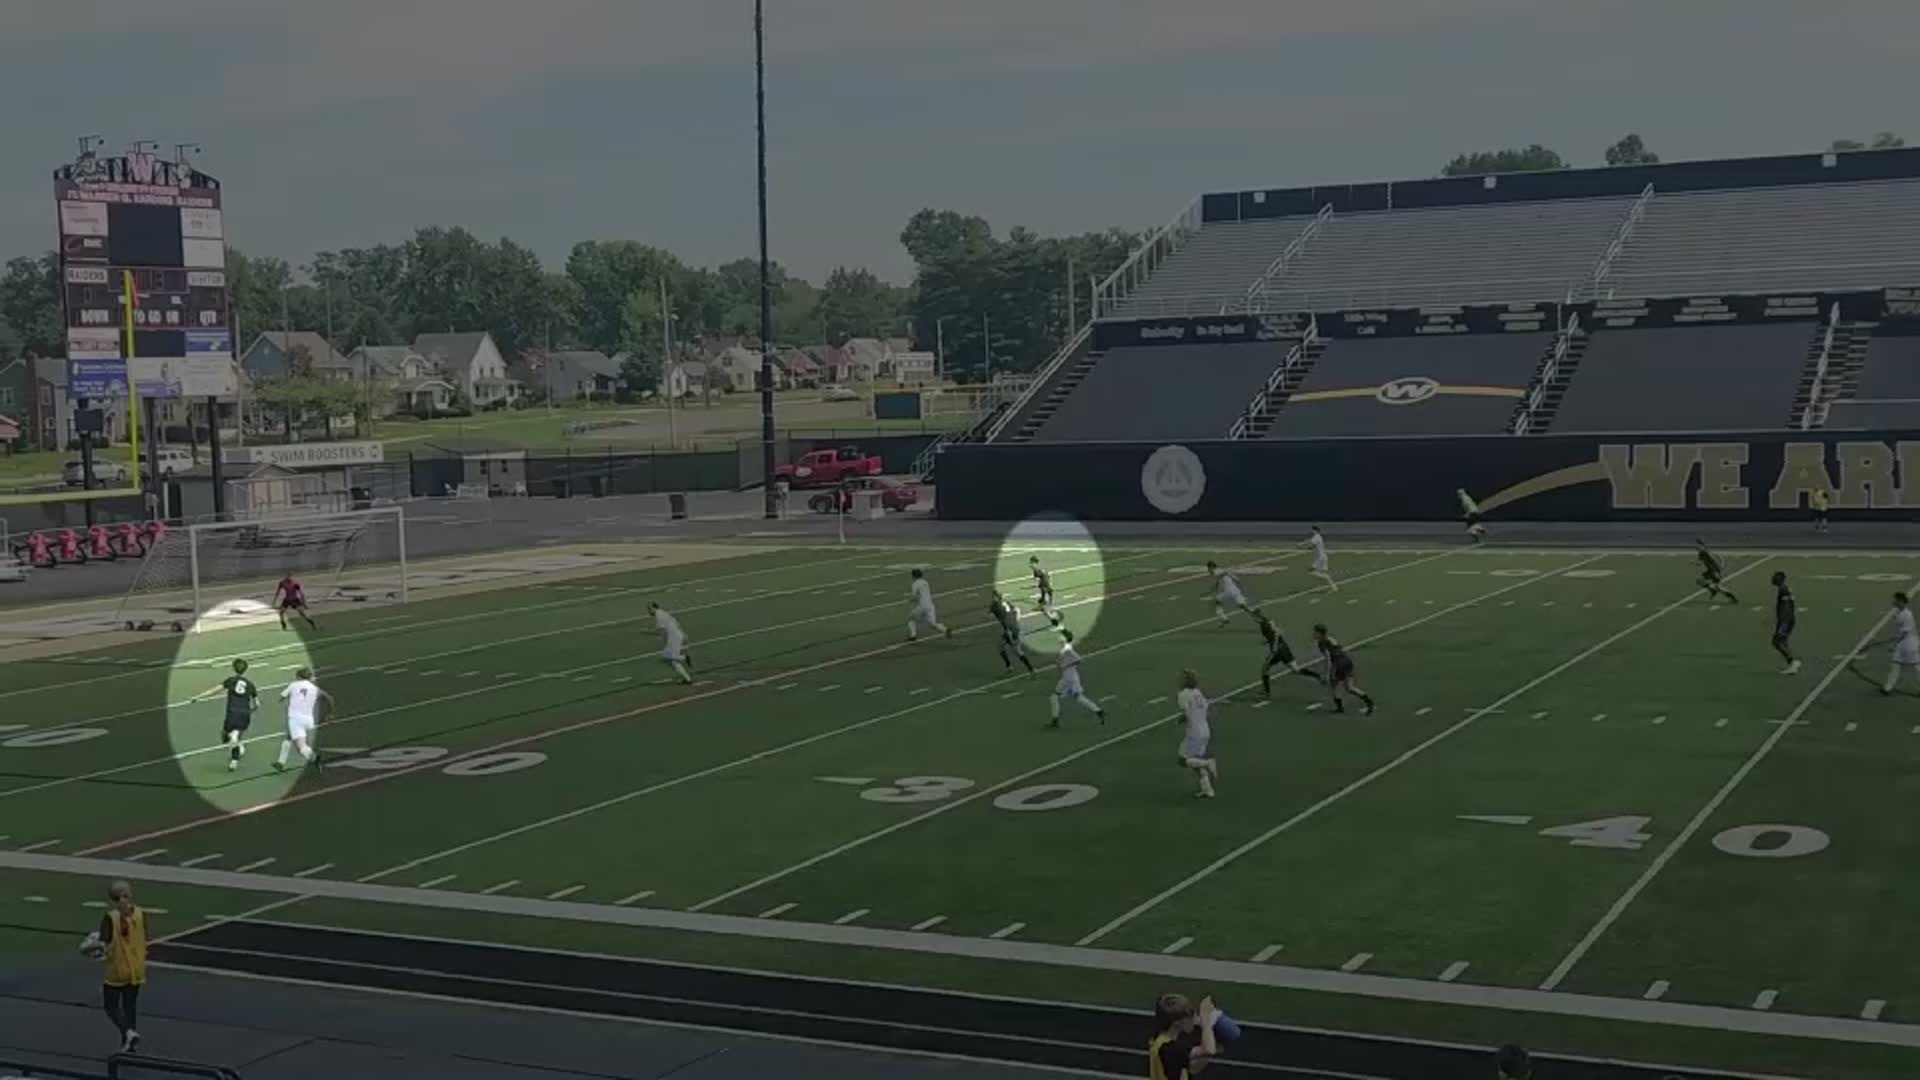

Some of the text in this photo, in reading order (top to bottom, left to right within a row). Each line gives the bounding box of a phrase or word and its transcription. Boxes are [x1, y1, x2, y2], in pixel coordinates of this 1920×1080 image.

[68, 271, 105, 282] RAIDERS
[270, 447, 367, 464] SWIM BOOSTERS
[1599, 443, 1750, 510] WE
[235, 680, 248, 695] 6
